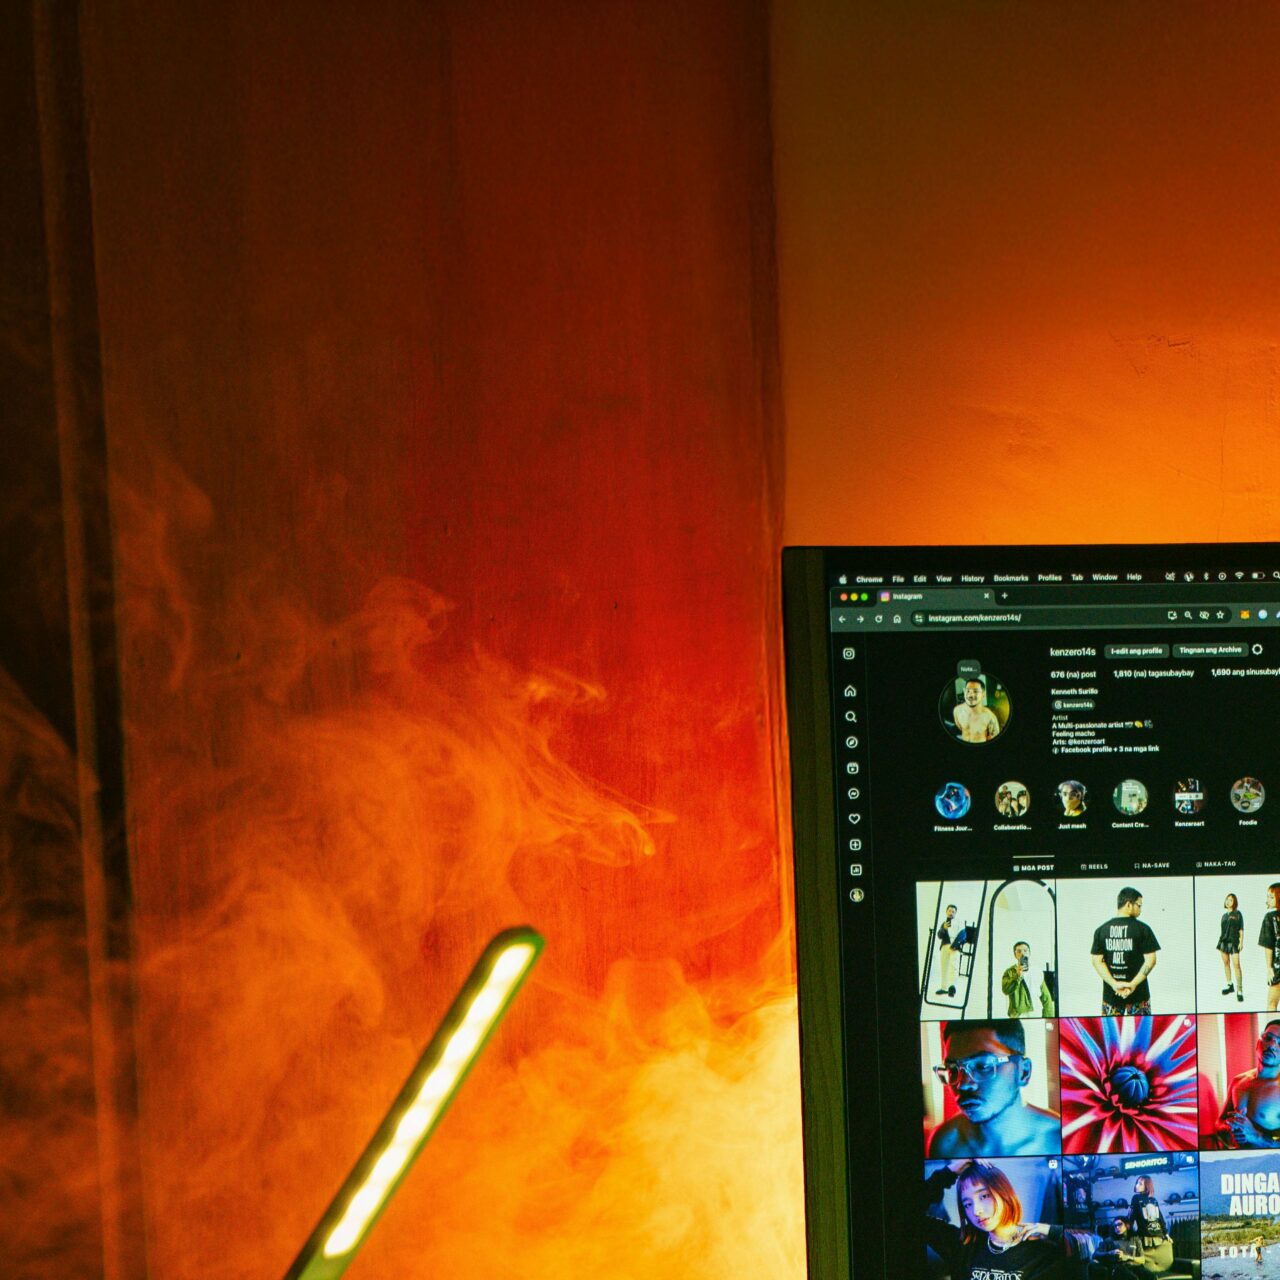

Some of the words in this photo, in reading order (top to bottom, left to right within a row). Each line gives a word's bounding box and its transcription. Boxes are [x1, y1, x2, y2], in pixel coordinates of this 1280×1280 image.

[856, 576, 883, 584] Chrome
[892, 575, 904, 583] File
[913, 575, 927, 583] Edit
[936, 575, 952, 583] View
[961, 574, 985, 584] History
[993, 574, 1029, 582] Bookmarks
[1038, 574, 1062, 582] Profiles
[1126, 573, 1142, 581] Help
[892, 592, 923, 601] Instagram
[928, 613, 1022, 623] instagram.com/kenzero14s/
[1050, 648, 1096, 657] kenzero14s
[1111, 647, 1129, 655] I-edit
[1129, 648, 1141, 656] ang
[1142, 647, 1163, 655] profile
[1179, 647, 1205, 655] Tingnan
[1050, 671, 1065, 679] 676
[1066, 670, 1080, 679] (na)
[1081, 671, 1096, 679] post
[1133, 670, 1147, 679] (na)
[1148, 669, 1195, 678] tagasubaybay
[1232, 669, 1245, 677] ang
[1052, 730, 1074, 738] Feeling
[1092, 746, 1112, 754] profile
[1109, 925, 1129, 938] DON'T
